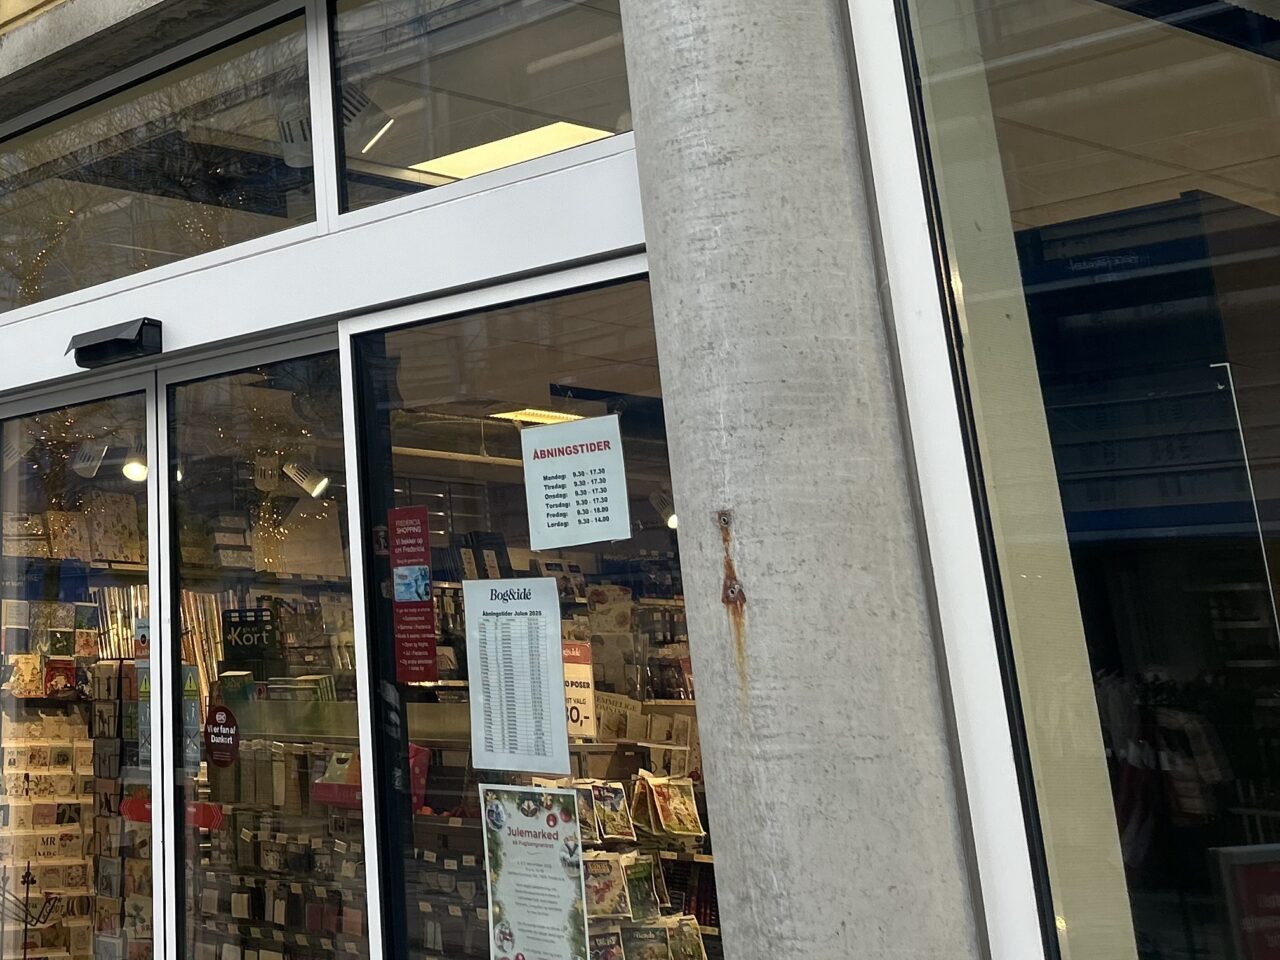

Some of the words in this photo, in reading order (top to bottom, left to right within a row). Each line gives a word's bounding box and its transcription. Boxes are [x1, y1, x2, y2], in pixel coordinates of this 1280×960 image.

[533, 440, 611, 460] ÅBNINGSTIDER
[489, 588, 532, 603] Bog&idé
[231, 626, 269, 646] Kort
[210, 735, 233, 744] Dankort
[507, 826, 559, 840] Julemarked
[41, 837, 56, 846] MR
